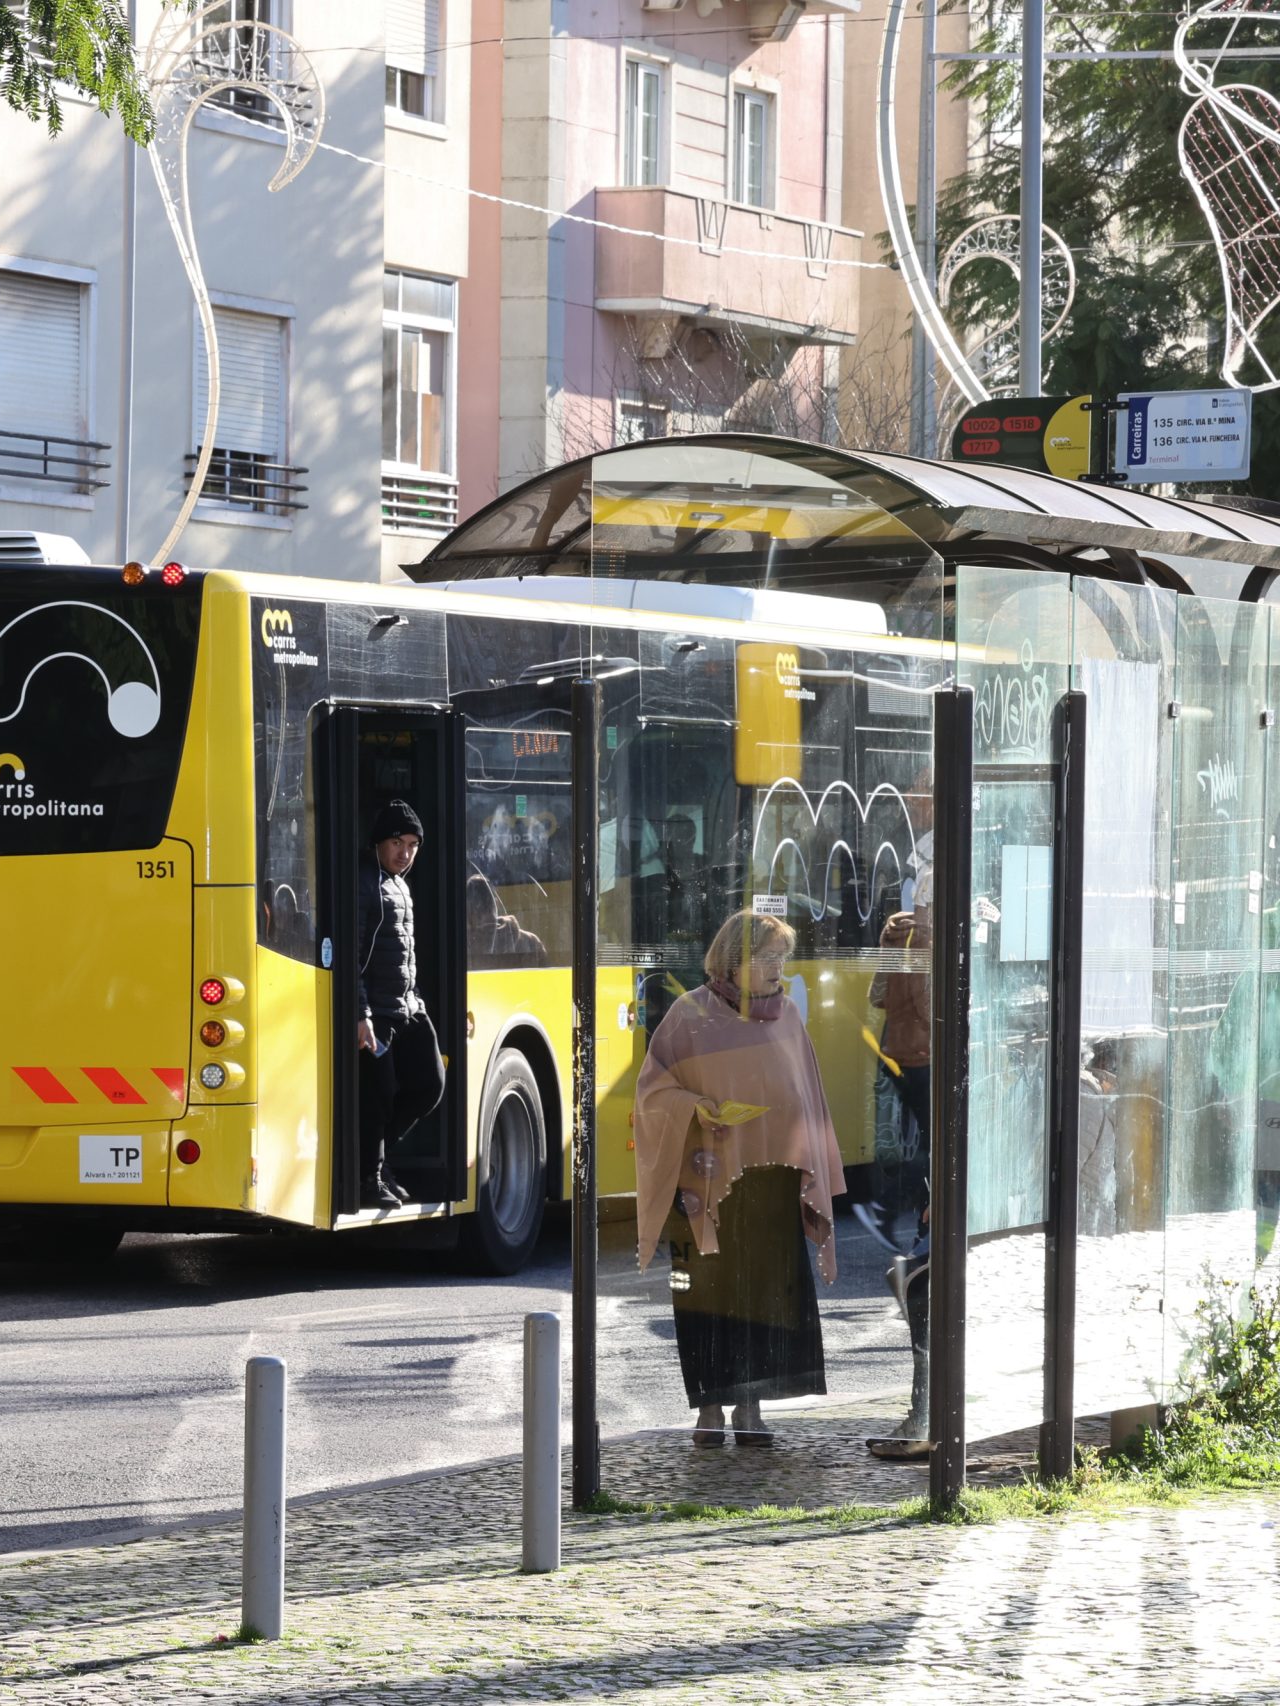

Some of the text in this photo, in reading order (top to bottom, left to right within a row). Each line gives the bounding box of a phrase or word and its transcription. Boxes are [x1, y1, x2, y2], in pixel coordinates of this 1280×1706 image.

[968, 419, 1034, 431] 1002 1518
[1153, 418, 1173, 428] 135
[1176, 419, 1194, 427] CIRC.
[1195, 418, 1206, 426] VIA
[1218, 416, 1236, 425] MINA
[1131, 411, 1143, 460] Carreiras
[1153, 434, 1240, 446] 136 CIRC. VIA M. FUNCHEIRA
[969, 442, 993, 452] 1717
[1148, 454, 1179, 464] Terminal
[273, 636, 296, 650] carris
[273, 650, 318, 667] metropolitana
[136, 861, 174, 879] 1351
[110, 1147, 140, 1167] TP
